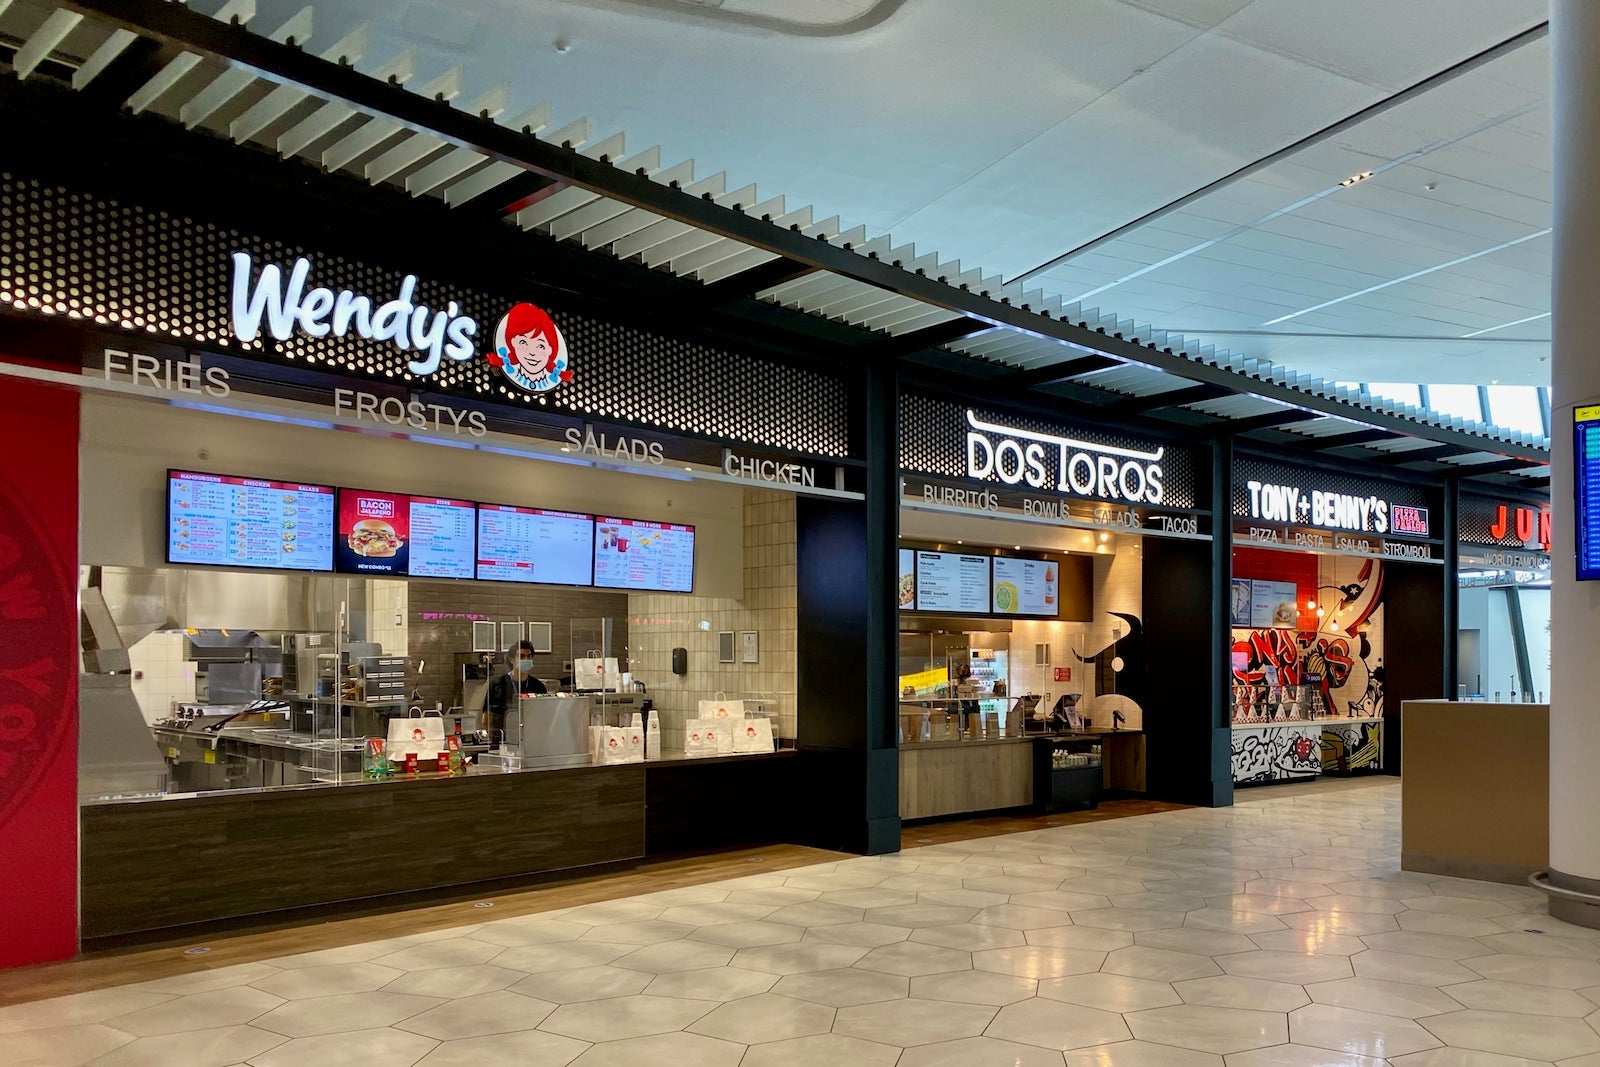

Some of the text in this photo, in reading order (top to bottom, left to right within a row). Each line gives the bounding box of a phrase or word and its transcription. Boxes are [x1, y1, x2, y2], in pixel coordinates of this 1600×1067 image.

[232, 252, 477, 375] Wendy's
[104, 349, 231, 398] FRIES
[334, 388, 487, 437] FROSTYS
[564, 428, 664, 465] SALADS
[967, 432, 1046, 488] DOS
[180, 473, 320, 493] HAMBURGERS CHICKEN SALADS
[724, 454, 815, 488] CHICKEN
[360, 500, 392, 510] BACON
[923, 484, 1198, 534] BURRITOS BOWLS SALADS TACOS
[1394, 507, 1420, 521] PIZZA
[1395, 518, 1427, 533] PARLOR
[1250, 527, 1431, 560] PIZZA PASTA SALAD STROMBOLI
[1483, 552, 1513, 567] WORLD
